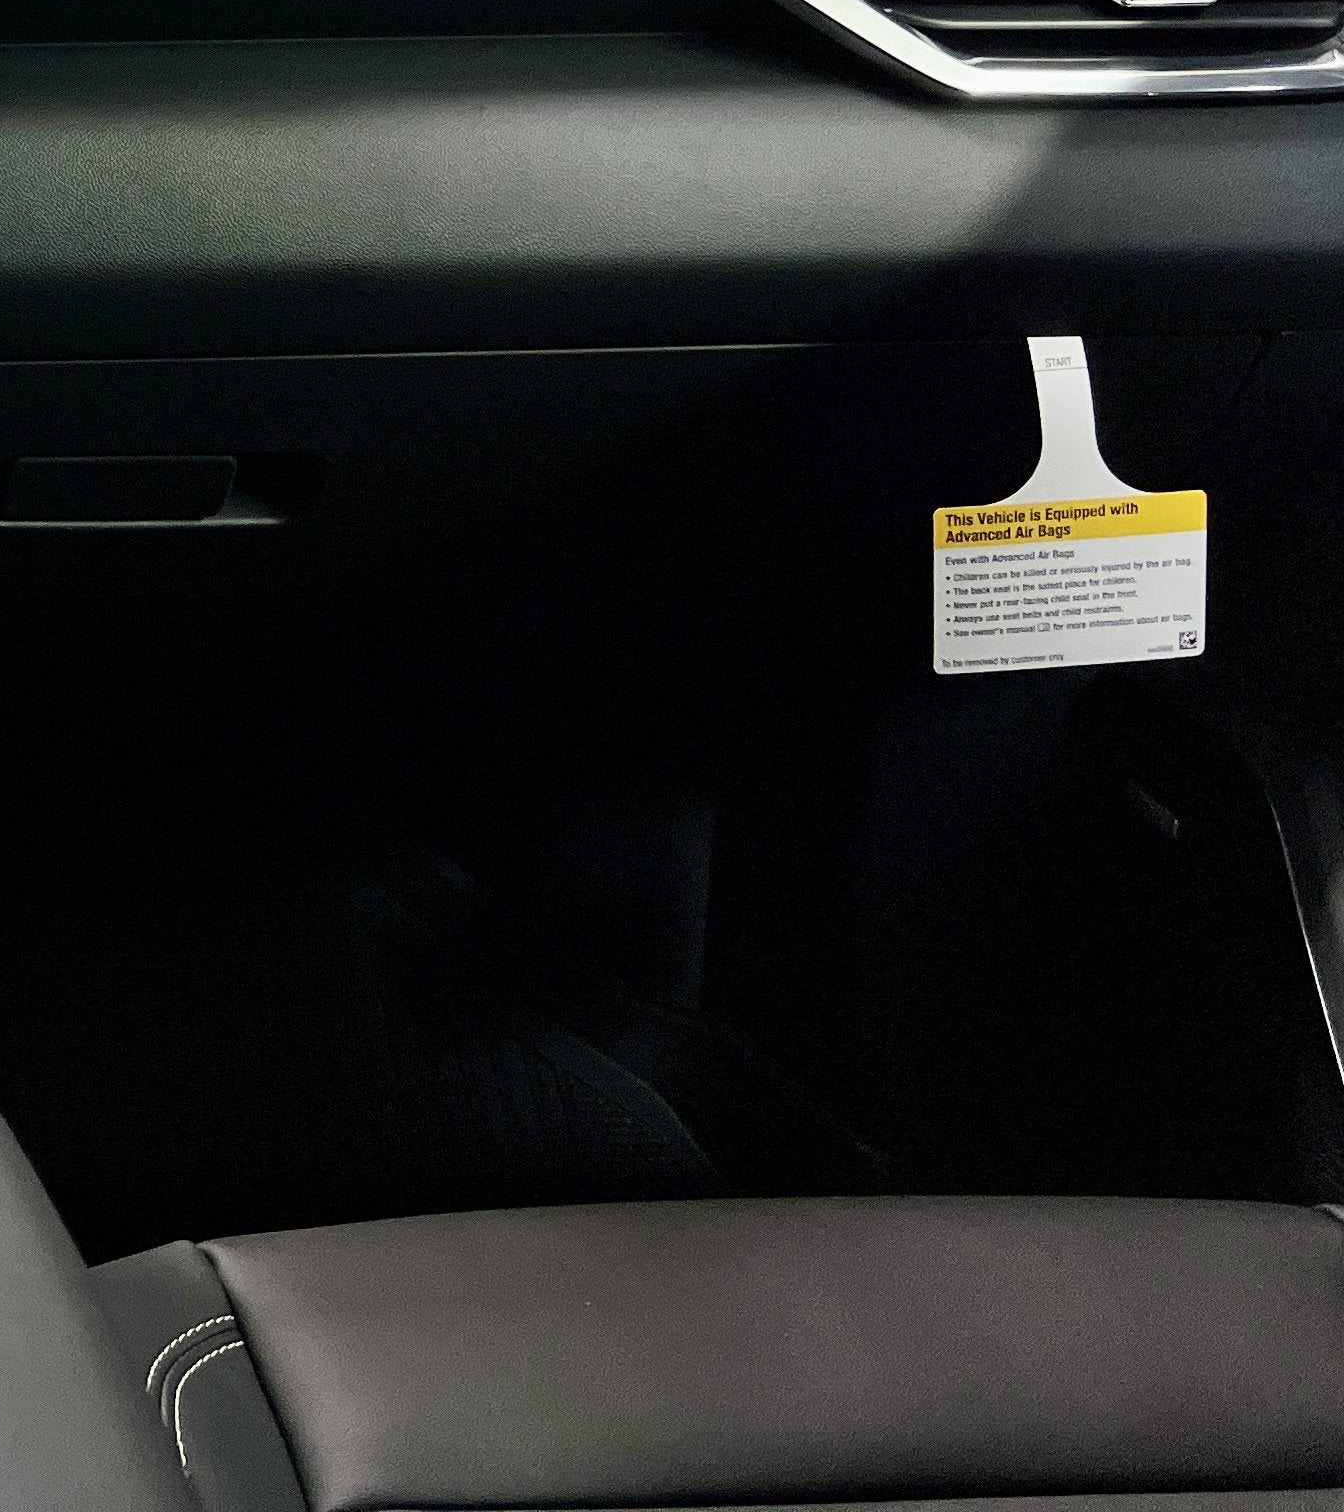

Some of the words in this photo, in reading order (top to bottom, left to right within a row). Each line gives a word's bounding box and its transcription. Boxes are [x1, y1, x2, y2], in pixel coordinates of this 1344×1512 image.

[1044, 356, 1072, 368] START
[945, 512, 974, 527] This
[977, 510, 1026, 525] Vehicle
[1030, 508, 1041, 522] is
[1045, 504, 1106, 522] Equipped
[1110, 502, 1139, 515] with
[945, 527, 1011, 544] Advanced
[1015, 526, 1034, 539] Air
[1038, 524, 1071, 539] Bags
[945, 556, 967, 566] Even
[970, 554, 990, 564] with
[992, 551, 1035, 562] Advanced
[1038, 550, 1050, 559] Air
[1052, 549, 1075, 559] Bags
[953, 572, 990, 582] Children
[992, 571, 1008, 580] can
[1010, 569, 1021, 578] be
[1133, 561, 1144, 571] by
[1146, 560, 1159, 568] the
[1162, 559, 1172, 567] air
[953, 587, 969, 595] The
[1089, 578, 1100, 587] for
[1102, 591, 1115, 599] the
[965, 657, 999, 666] removed
[1011, 655, 1047, 664] customer
